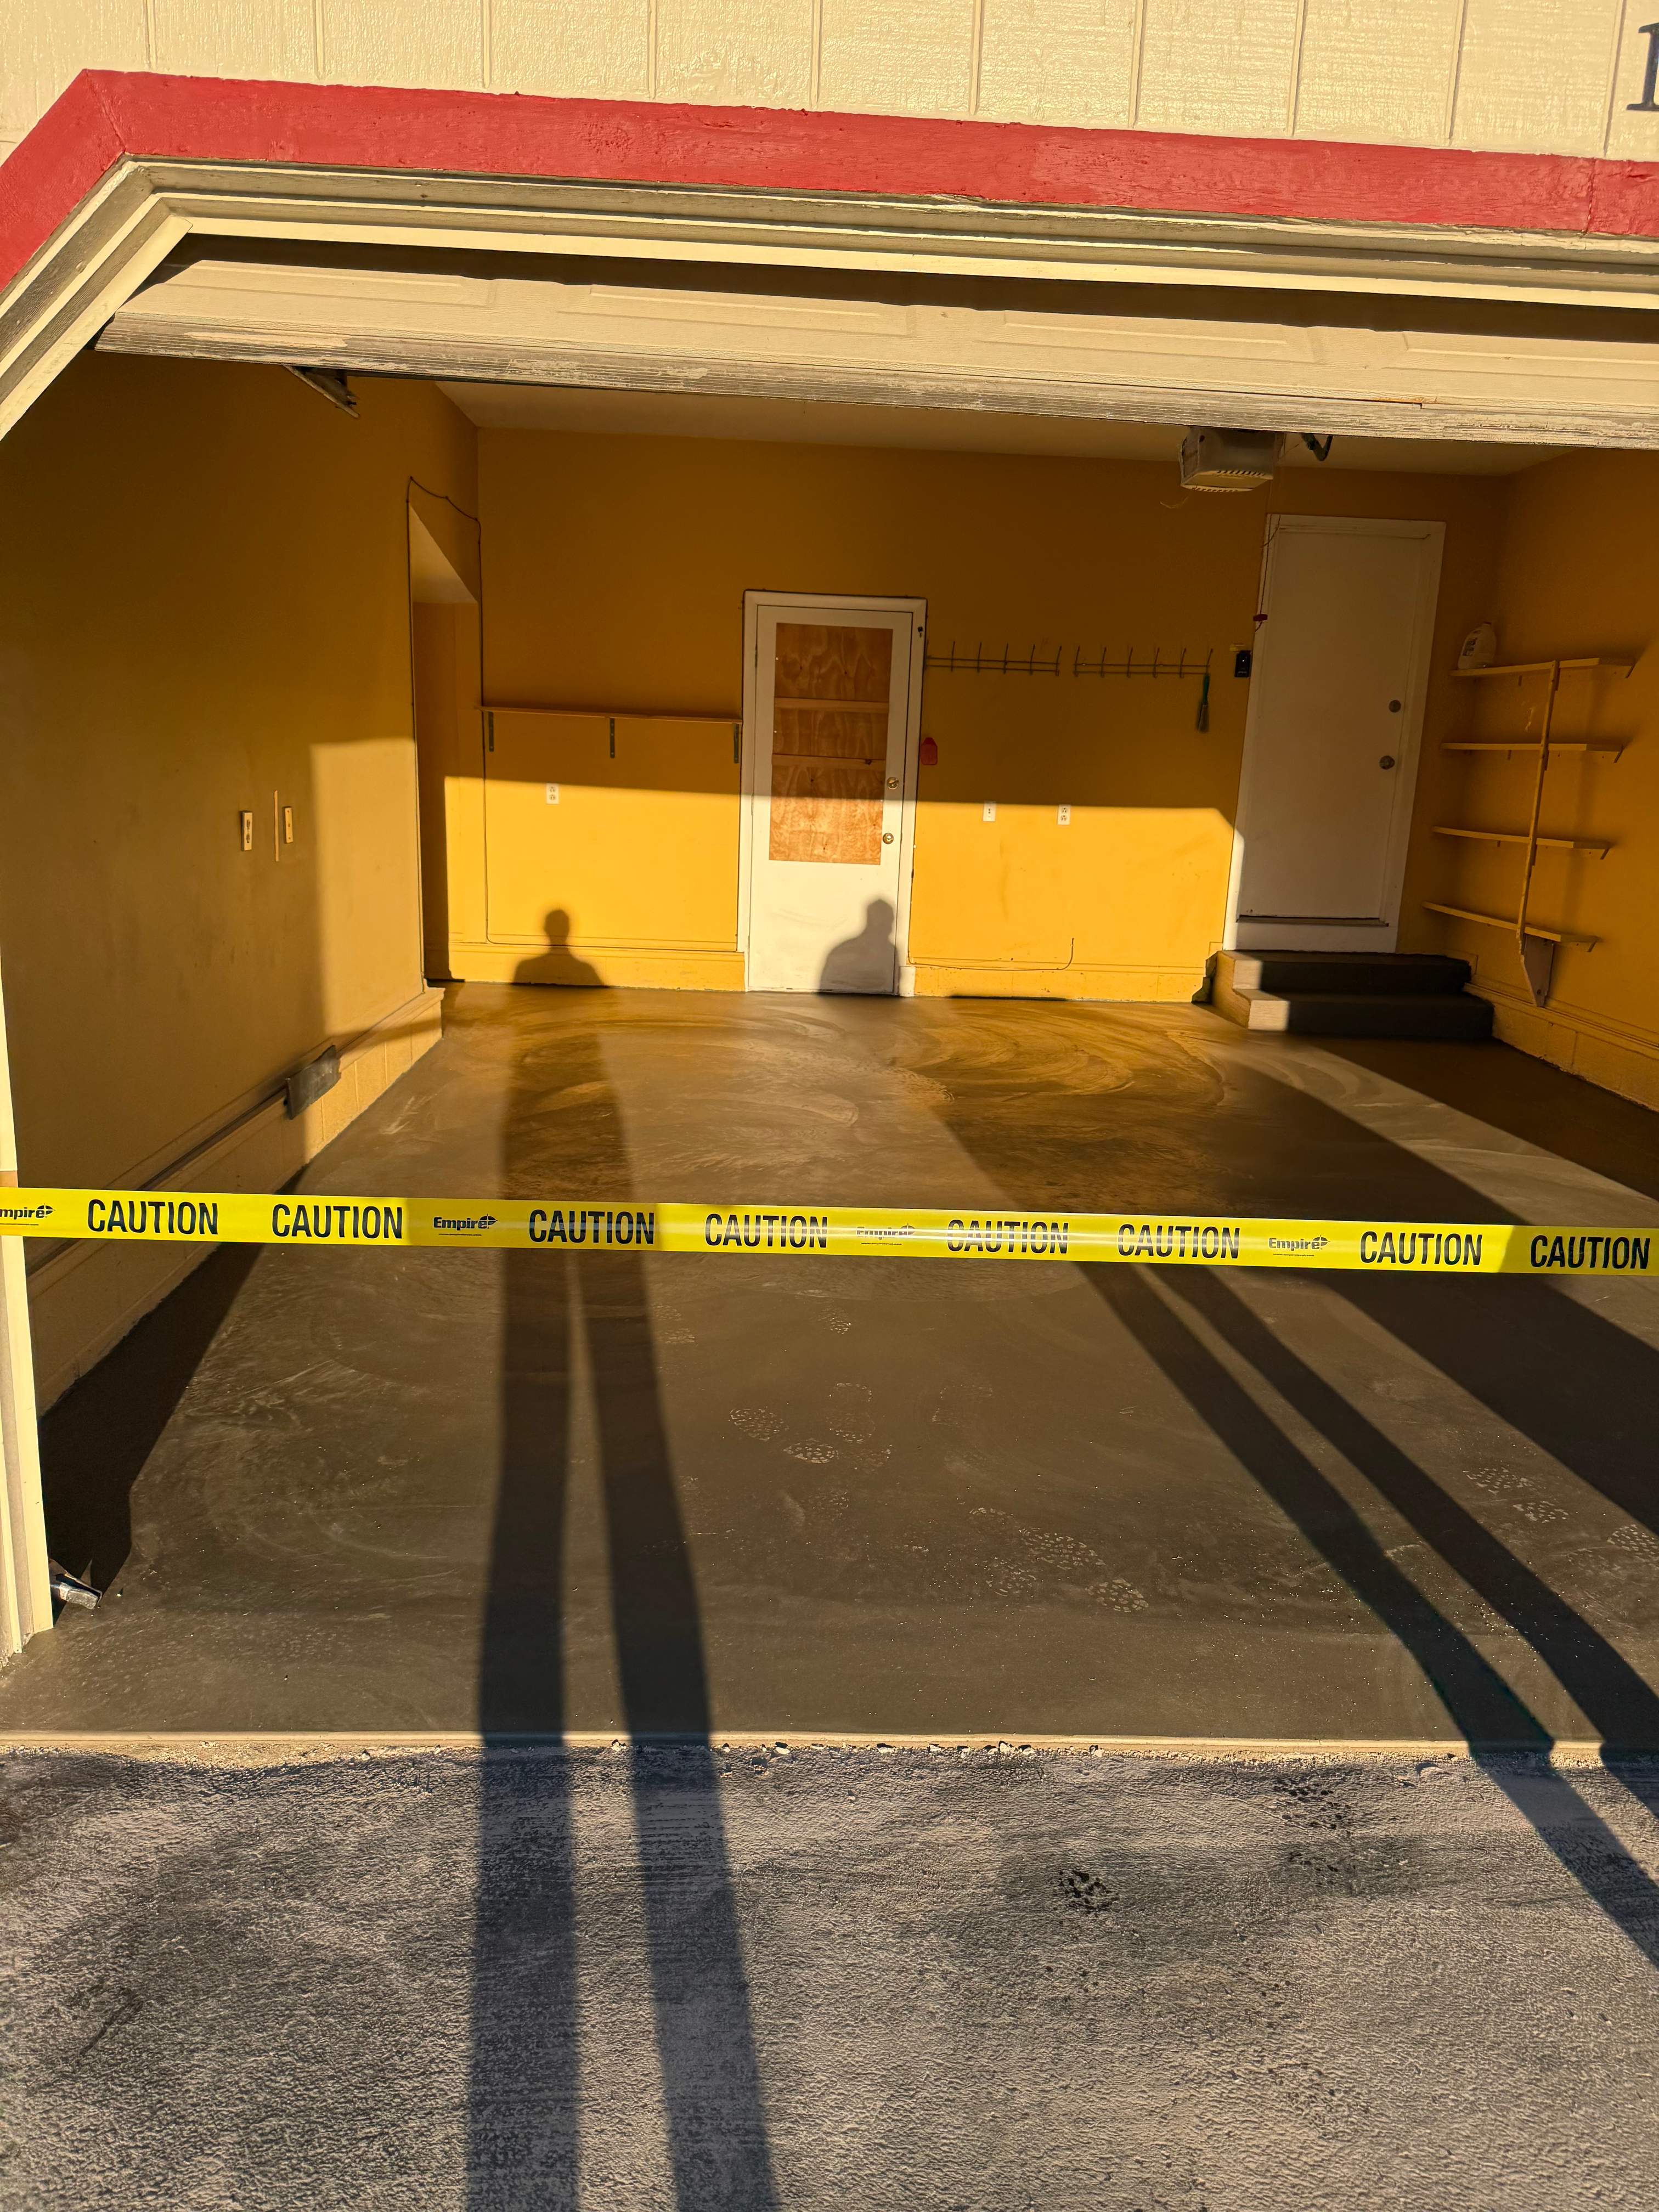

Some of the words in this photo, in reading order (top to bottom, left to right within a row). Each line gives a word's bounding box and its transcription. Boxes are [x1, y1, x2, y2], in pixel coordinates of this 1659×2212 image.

[0, 1207, 45, 1220] mpire
[88, 1199, 218, 1235] CAUTION
[272, 1204, 402, 1239] CAUTION
[433, 1217, 488, 1231] Empire
[529, 1209, 654, 1244] CAUTION
[705, 1214, 827, 1249] CAUTION
[947, 1220, 1069, 1254] CAUTION
[1118, 1224, 1240, 1259] CAUTION
[1269, 1238, 1320, 1251] Empire
[1361, 1231, 1482, 1265] CAUTION
[1531, 1235, 1650, 1269] CAUTION
